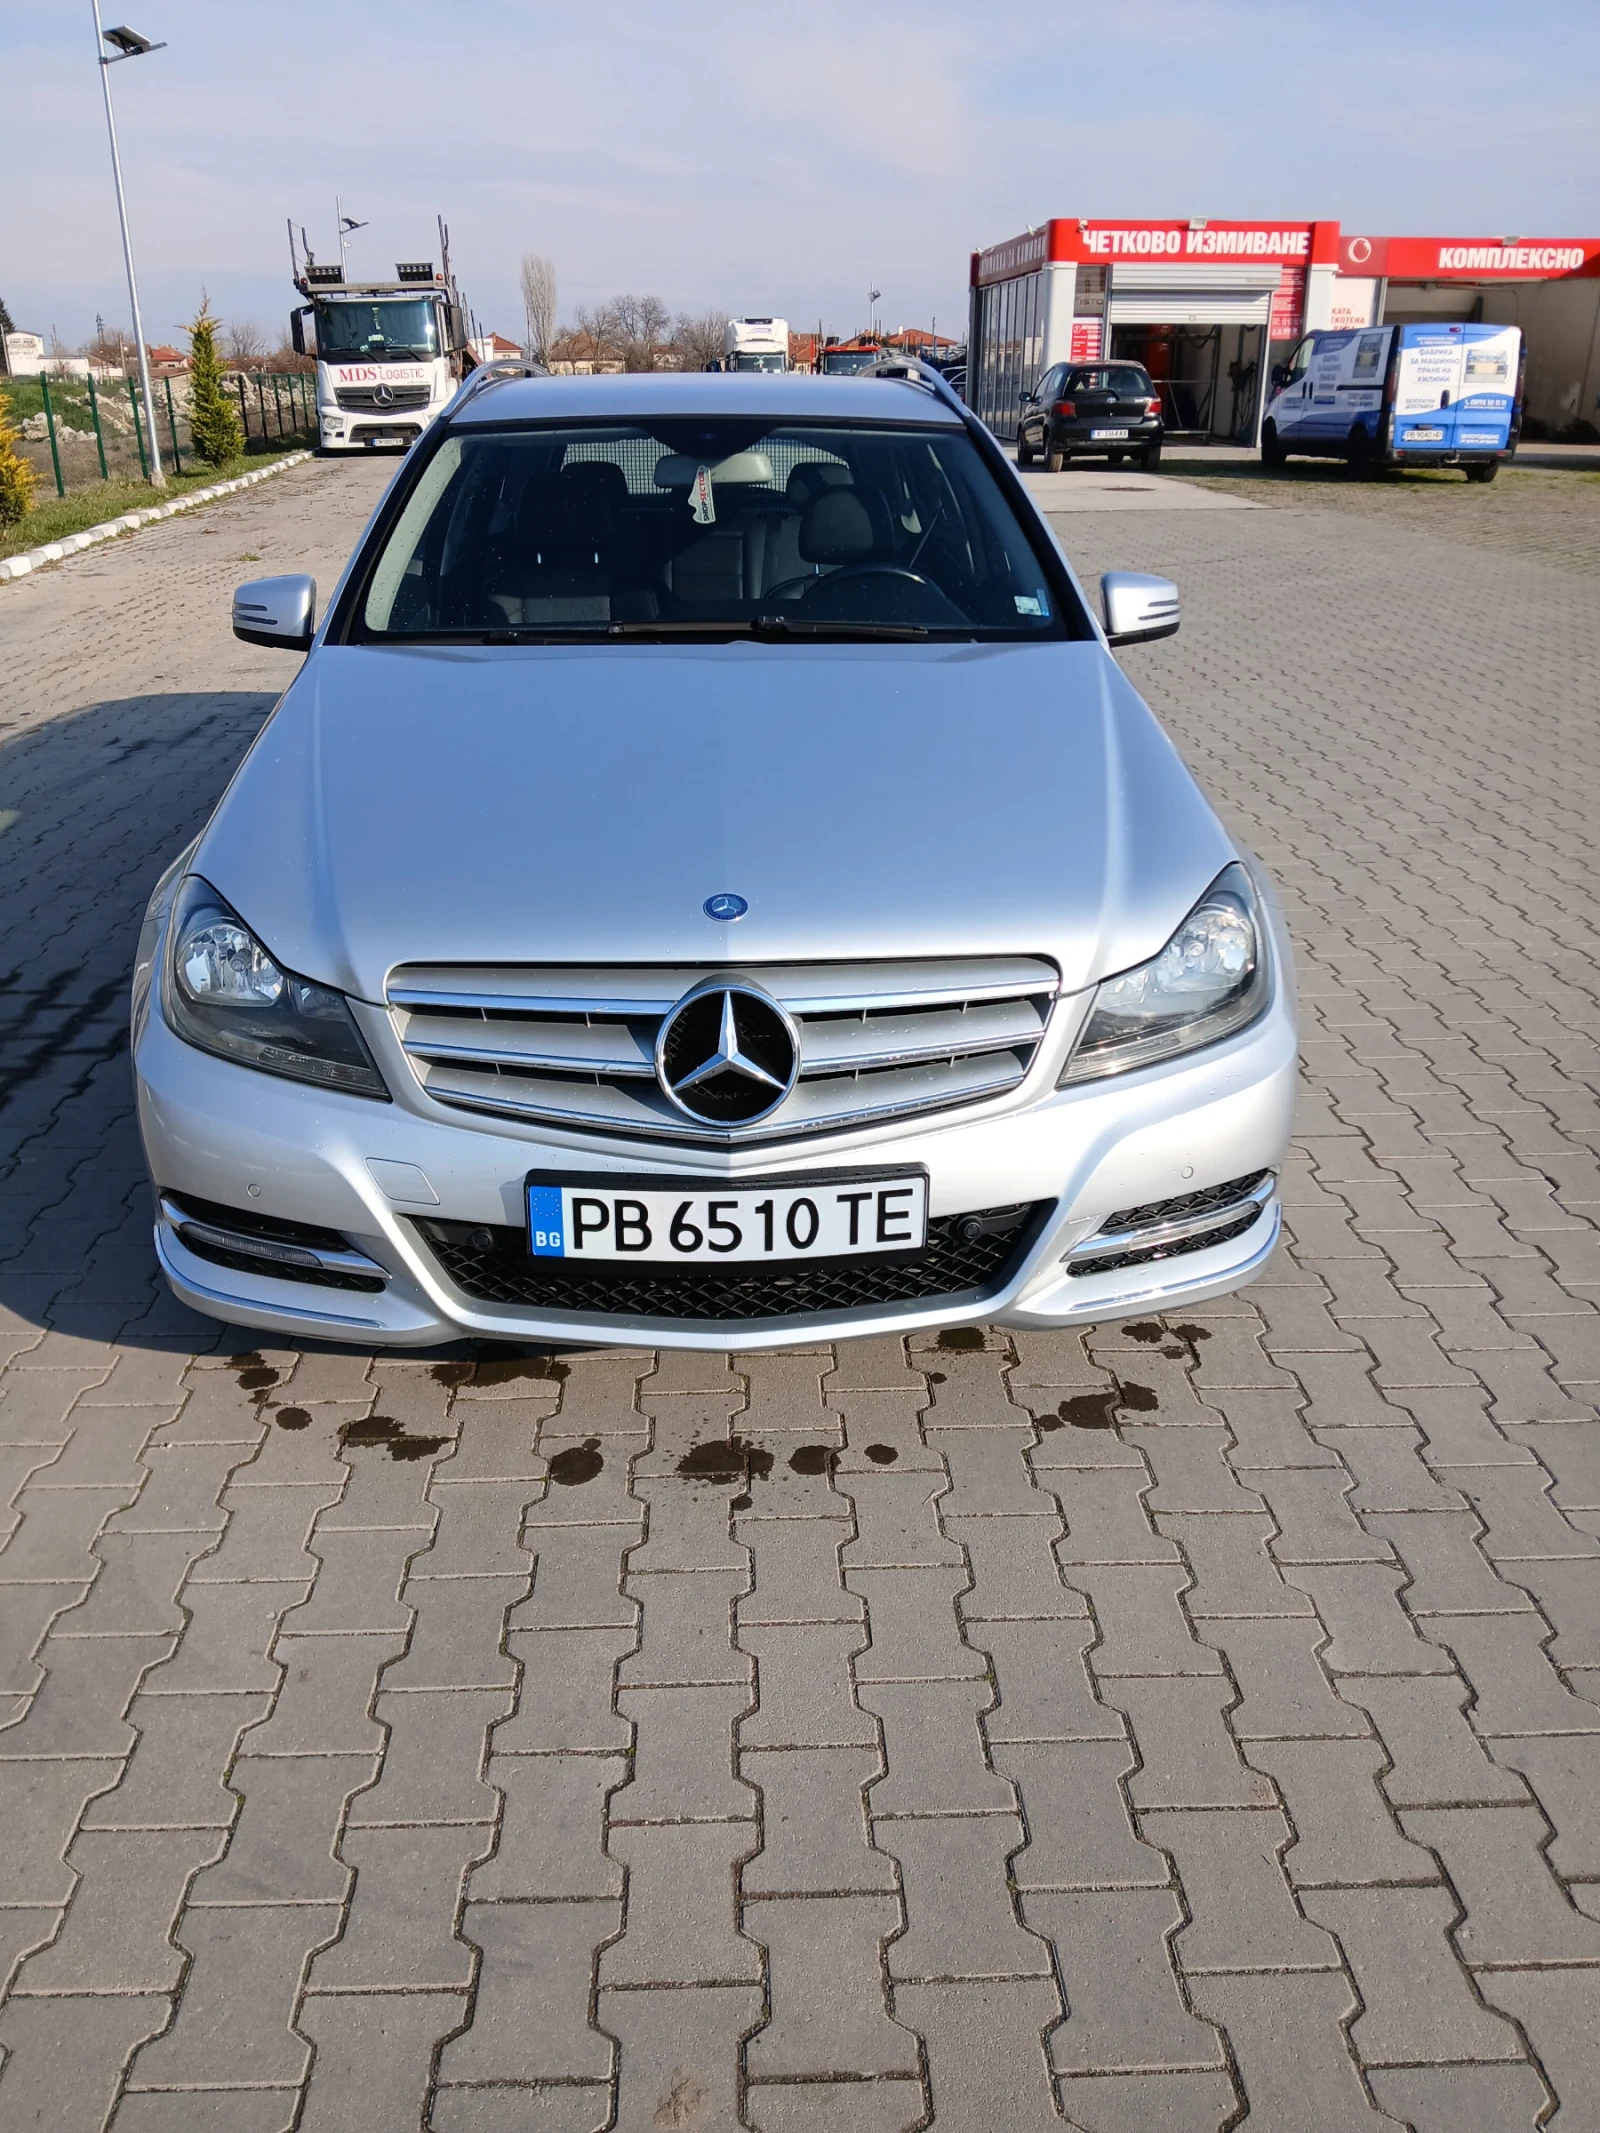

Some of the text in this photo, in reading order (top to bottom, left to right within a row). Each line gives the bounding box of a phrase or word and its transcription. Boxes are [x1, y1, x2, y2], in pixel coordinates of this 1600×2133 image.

[1083, 230, 1310, 255] ЧЕТКОВО ИЗМИВАНЕ
[1438, 247, 1585, 269] КОМПЛЕКСНО
[338, 367, 425, 382] MDS LOGISTIC
[536, 1188, 914, 1252] BG PB 6510 TE
